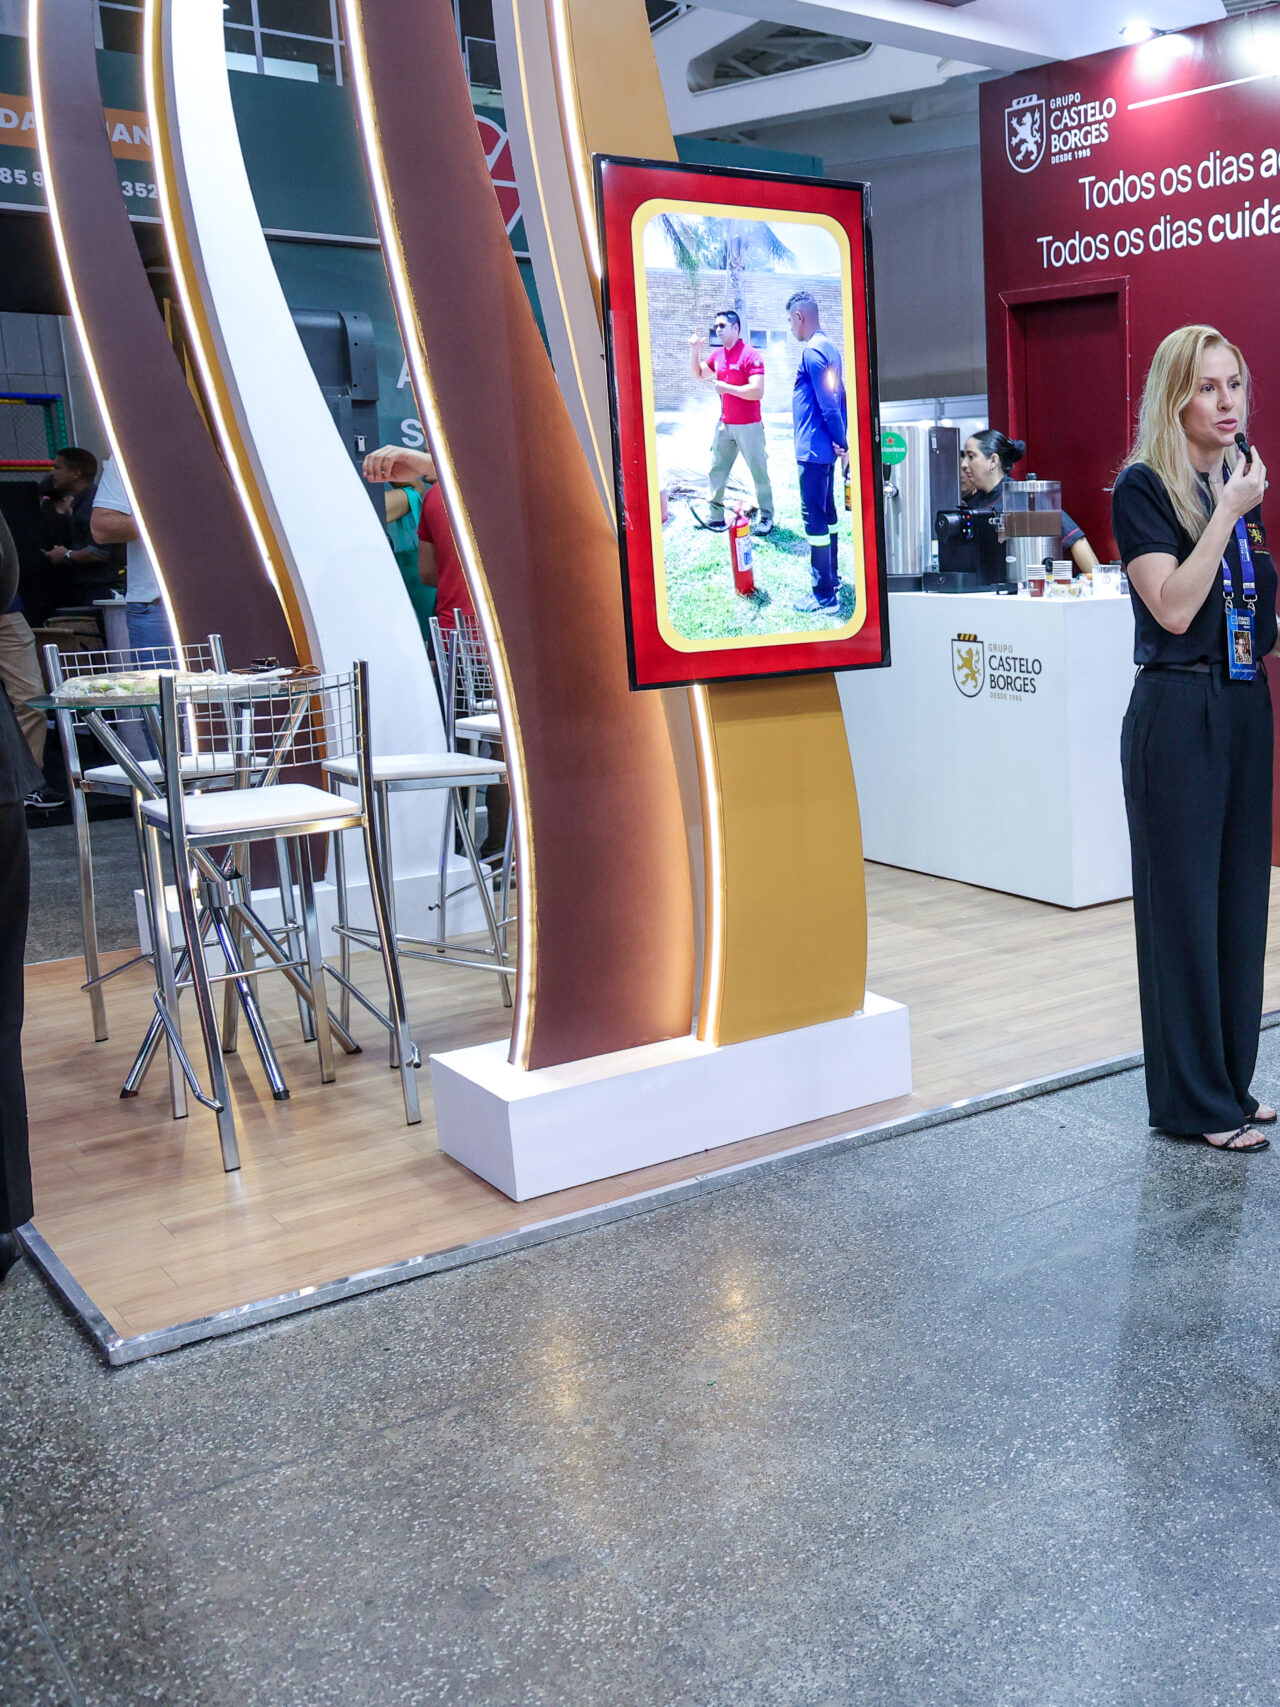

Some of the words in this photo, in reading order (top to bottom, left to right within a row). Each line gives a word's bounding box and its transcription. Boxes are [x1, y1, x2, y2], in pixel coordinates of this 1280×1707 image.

[1050, 92, 1081, 109] GRUPO
[1050, 97, 1117, 131] CASTELO
[1051, 121, 1110, 153] BORGES
[1051, 152, 1073, 165] DESDE
[1078, 169, 1156, 210] Todos
[1159, 164, 1193, 196] os
[1197, 150, 1255, 189] dias
[1036, 230, 1110, 269] Todos
[1113, 227, 1145, 258] os
[1149, 214, 1203, 252] dias
[988, 643, 1013, 654] GRUPO
[988, 654, 1042, 675] CASTELO
[989, 674, 1037, 694] BORGES
